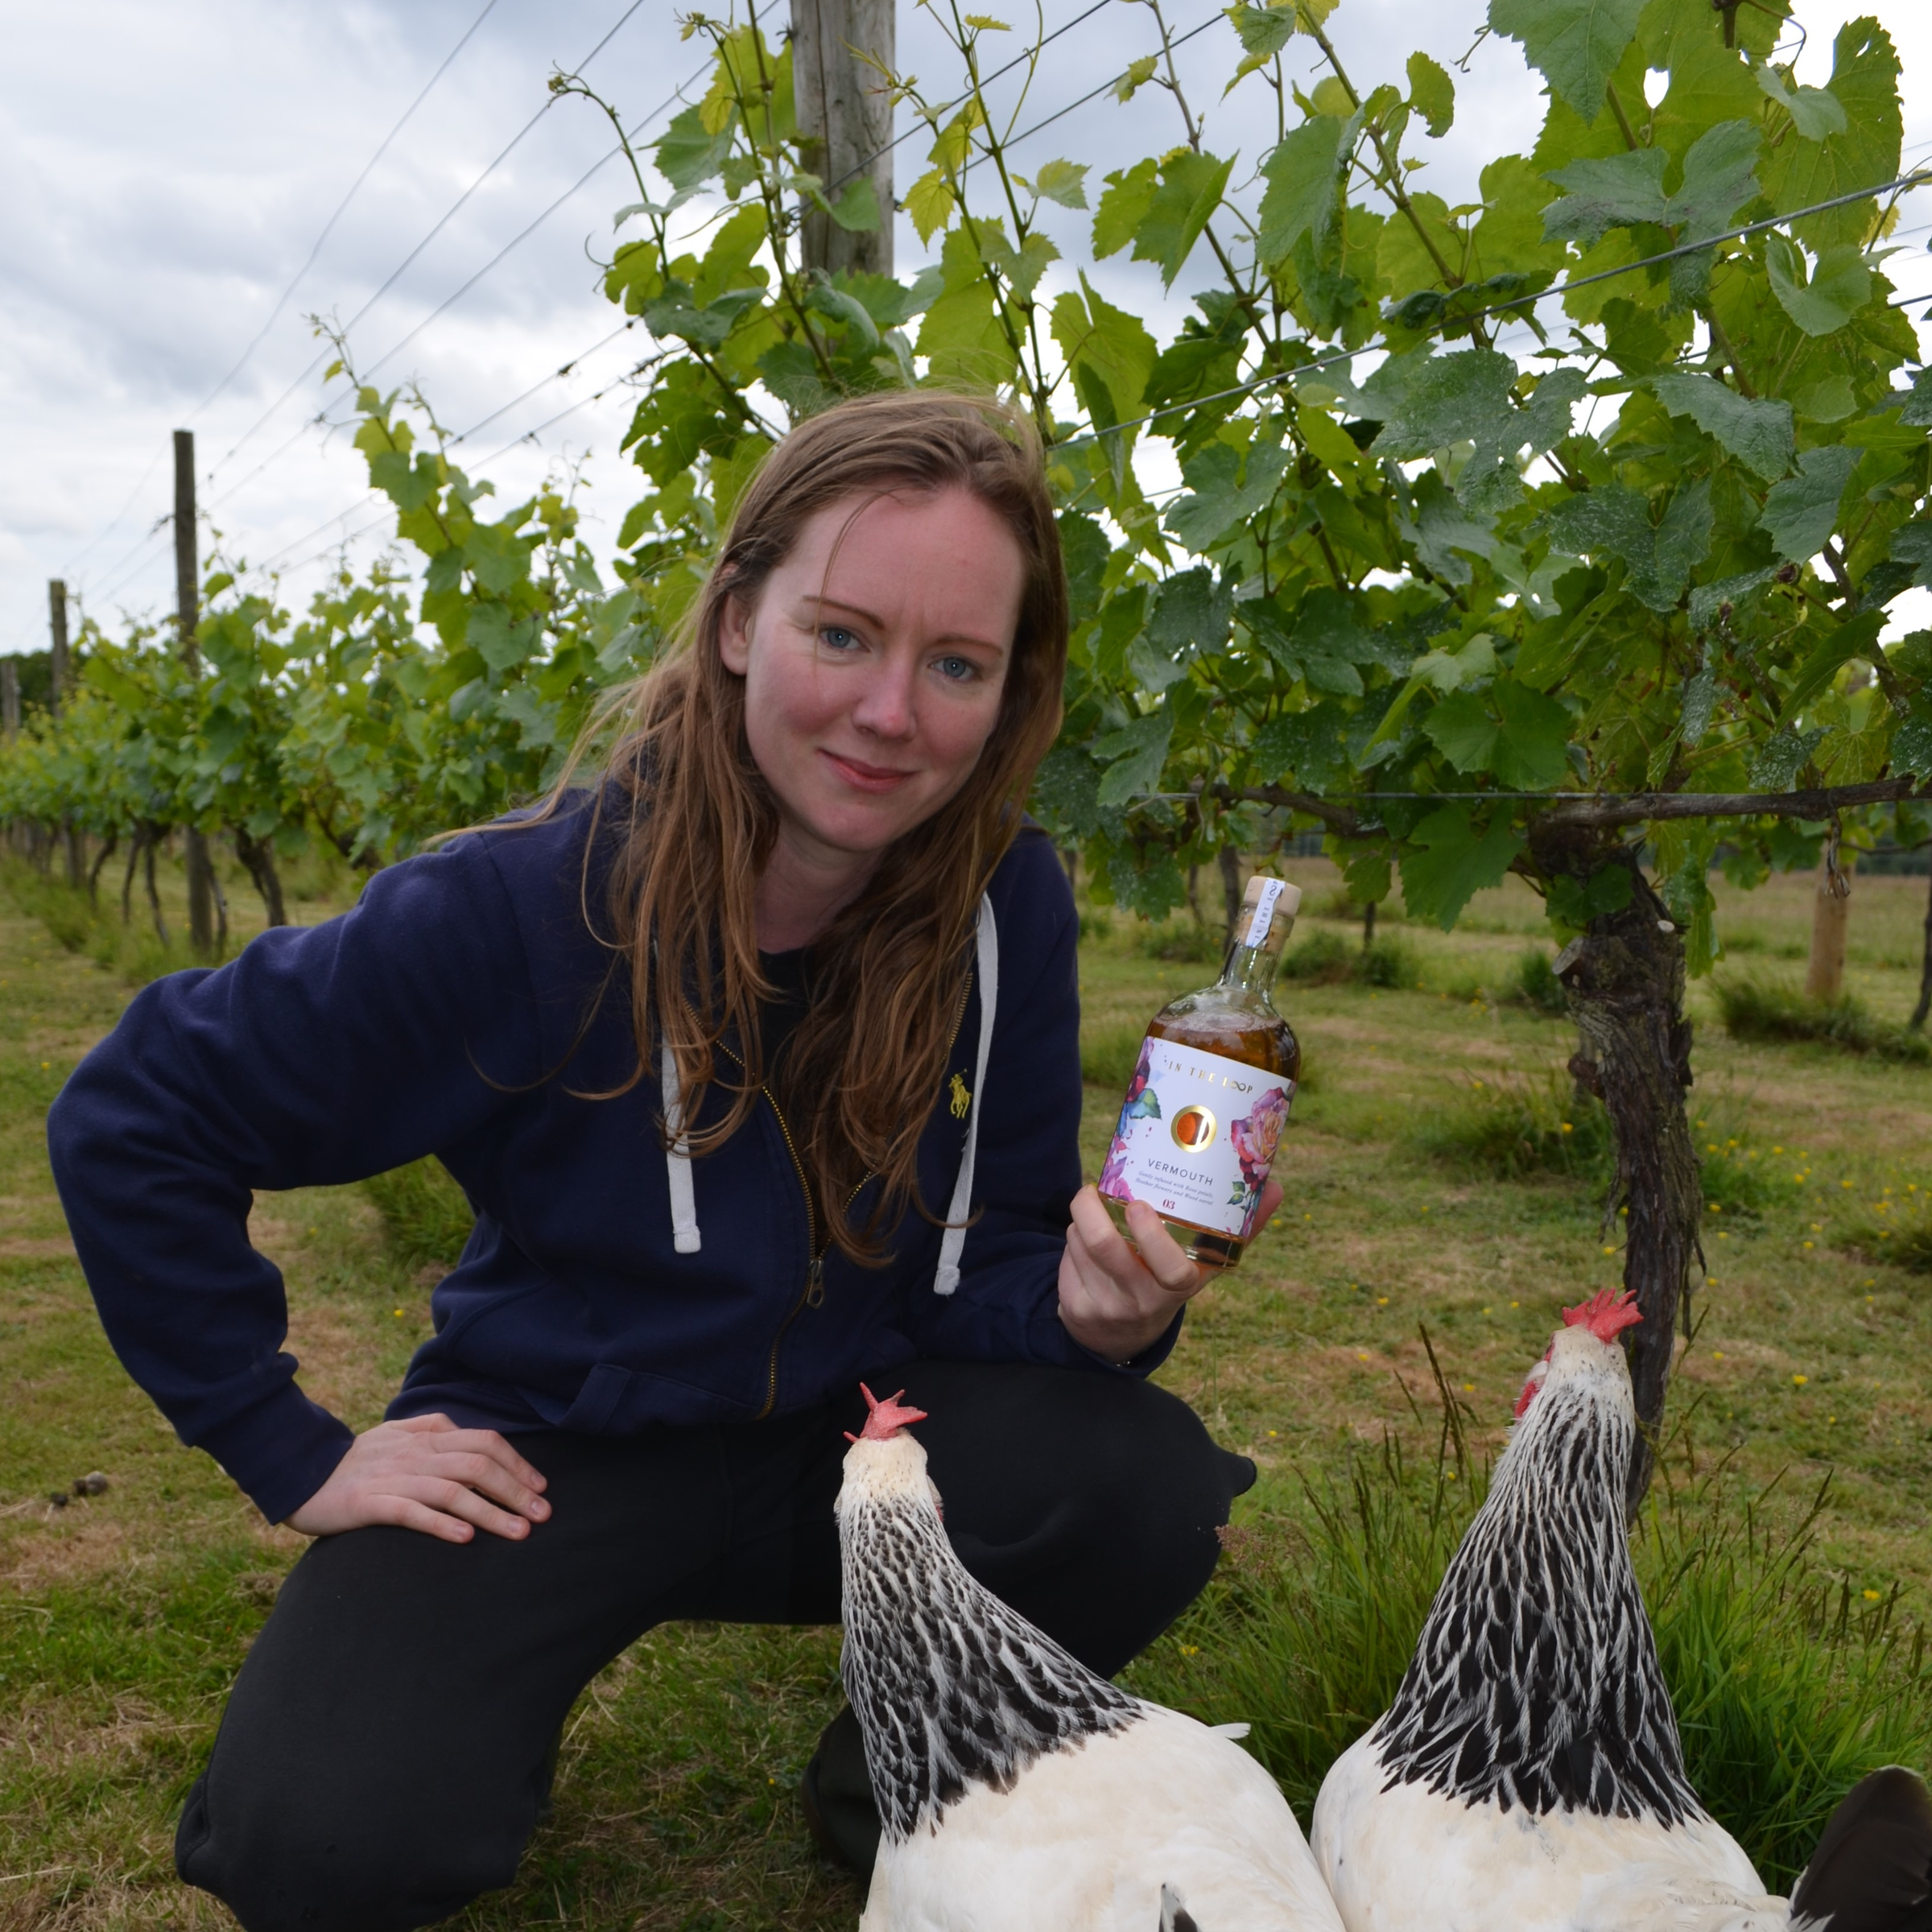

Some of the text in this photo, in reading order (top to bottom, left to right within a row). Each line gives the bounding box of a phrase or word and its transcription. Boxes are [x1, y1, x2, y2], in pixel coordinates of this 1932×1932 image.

[1168, 1060, 1181, 1072] IN
[1189, 1067, 1216, 1083] THE
[1148, 1158, 1214, 1187] VERMOUTH
[1153, 1183, 1173, 1193] flowers
[1154, 1175, 1173, 1185] infused
[1185, 1185, 1198, 1193] Rose
[1162, 1198, 1175, 1210] 03
